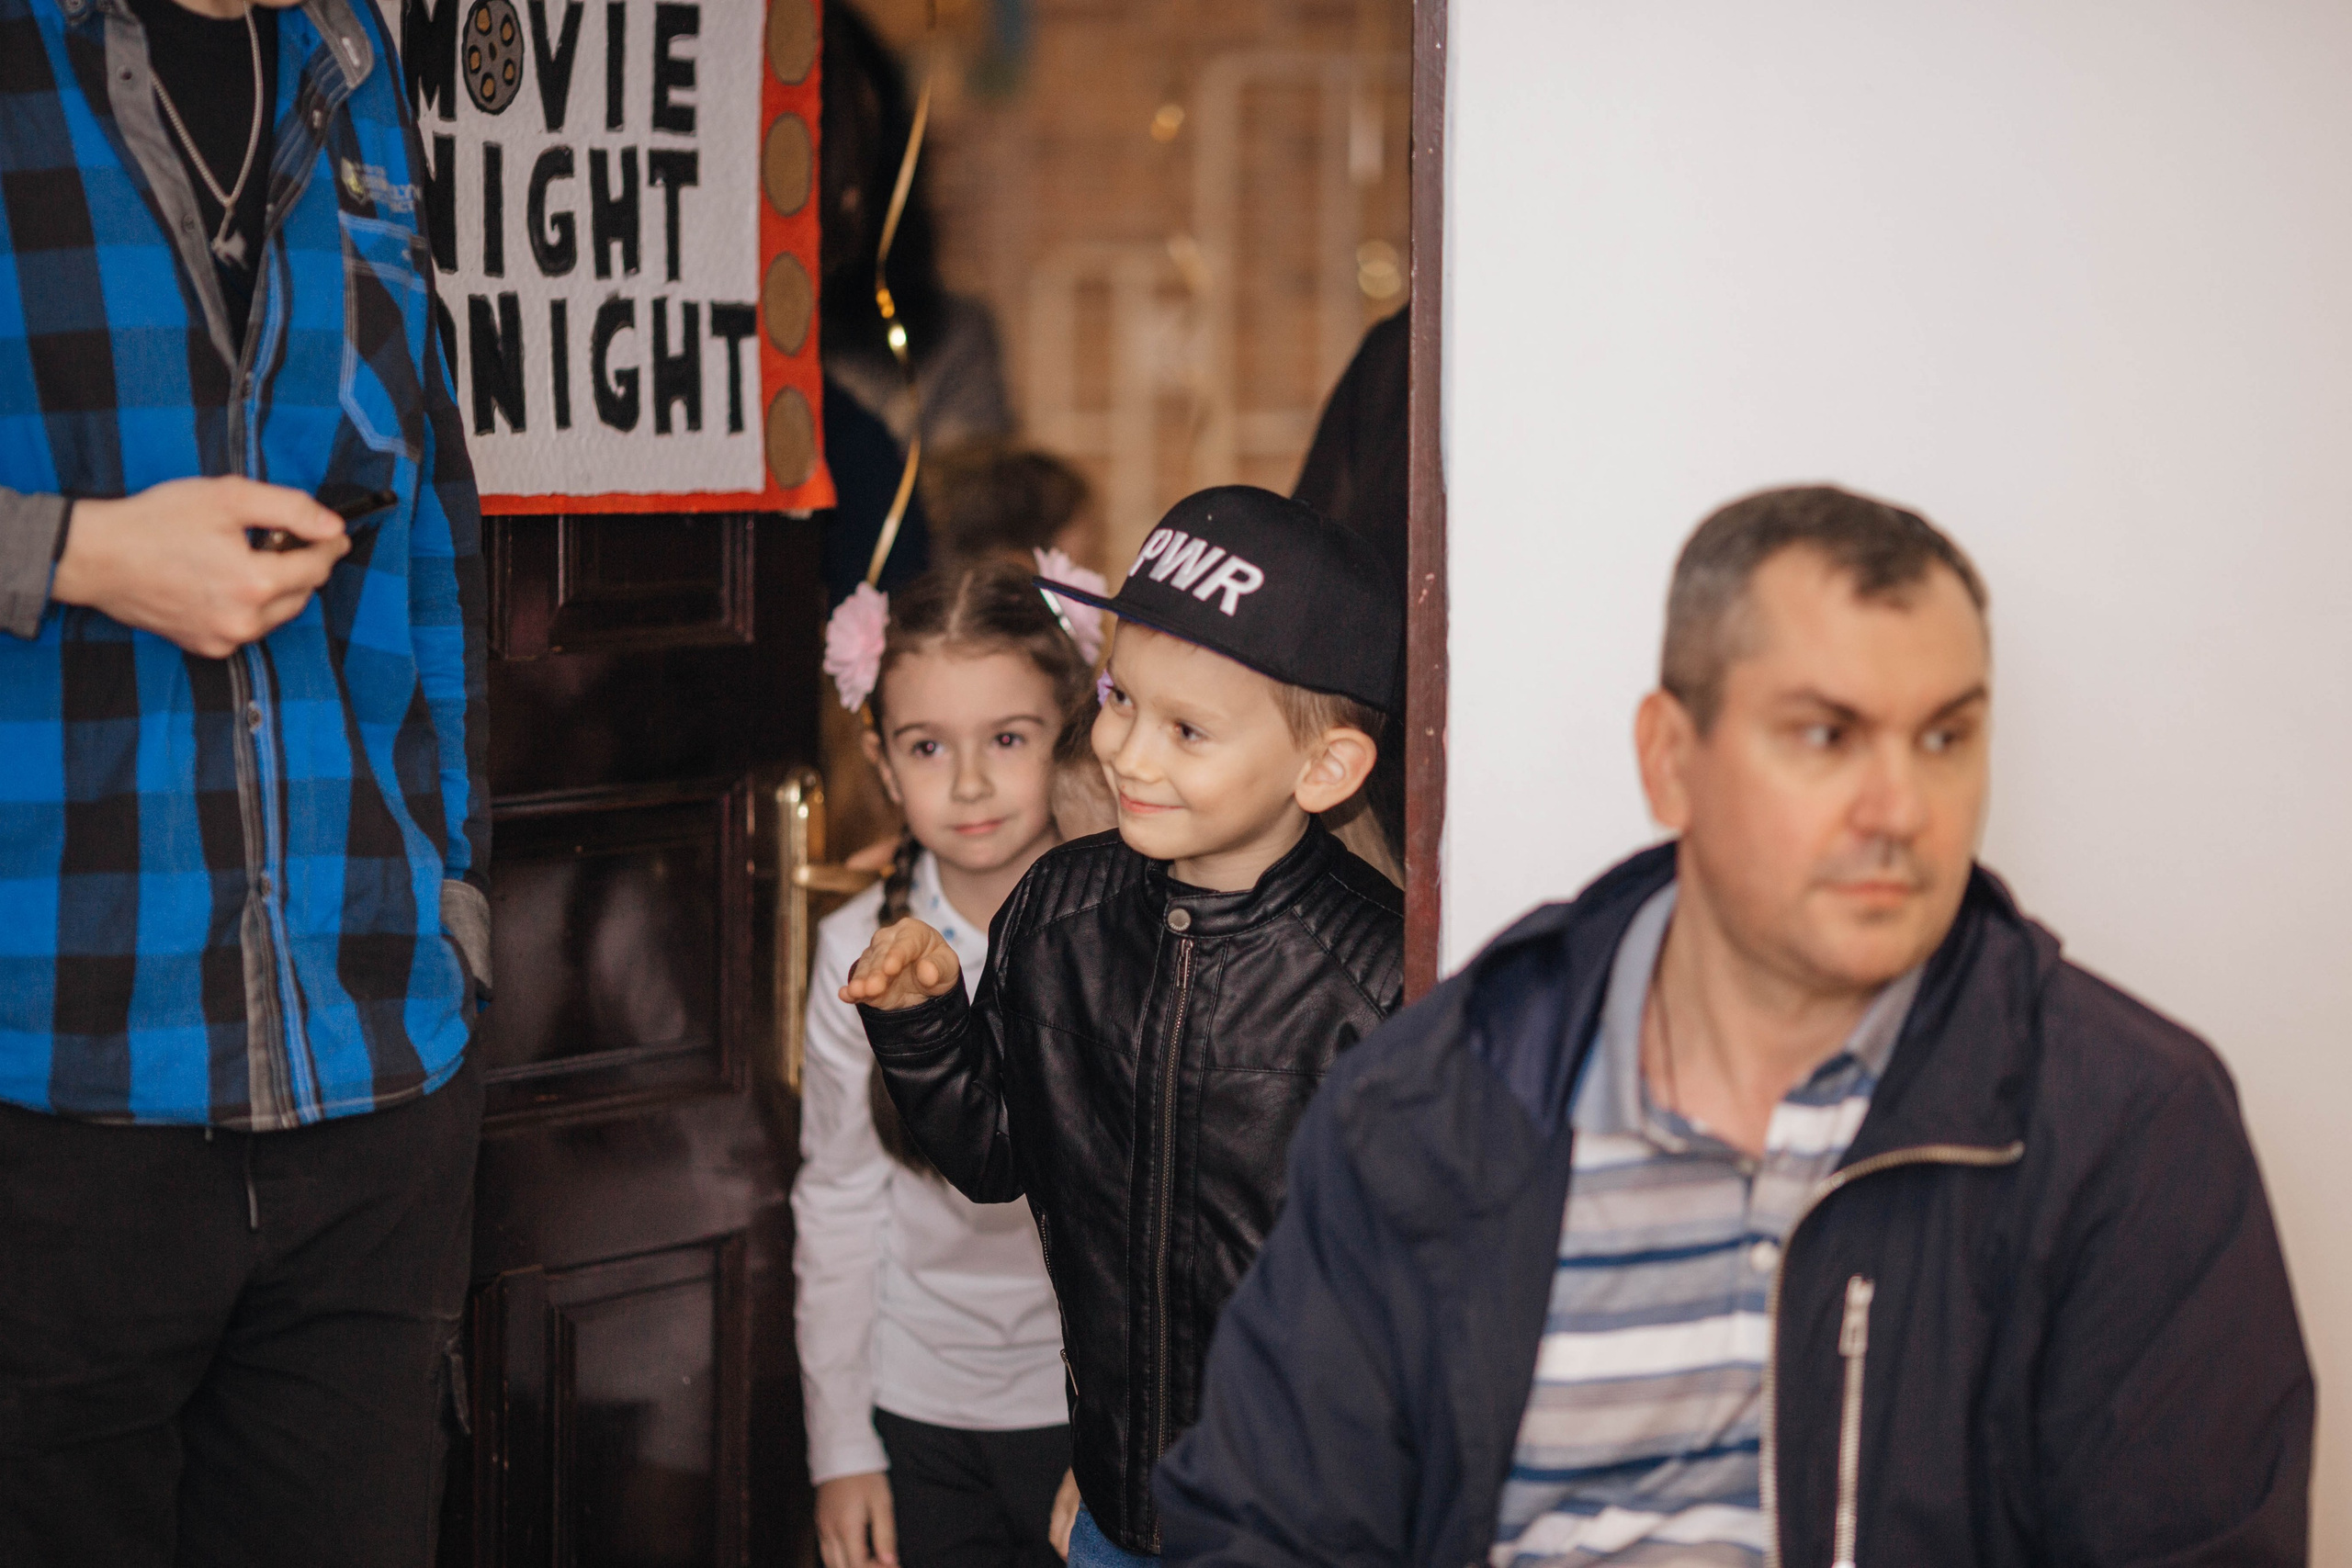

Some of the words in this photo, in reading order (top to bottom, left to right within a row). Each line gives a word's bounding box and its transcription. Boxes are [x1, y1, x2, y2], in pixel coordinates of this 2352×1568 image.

[401, 0, 700, 133] MOVIE
[435, 290, 758, 435] NIGHT
[1128, 528, 1264, 617] PWR
